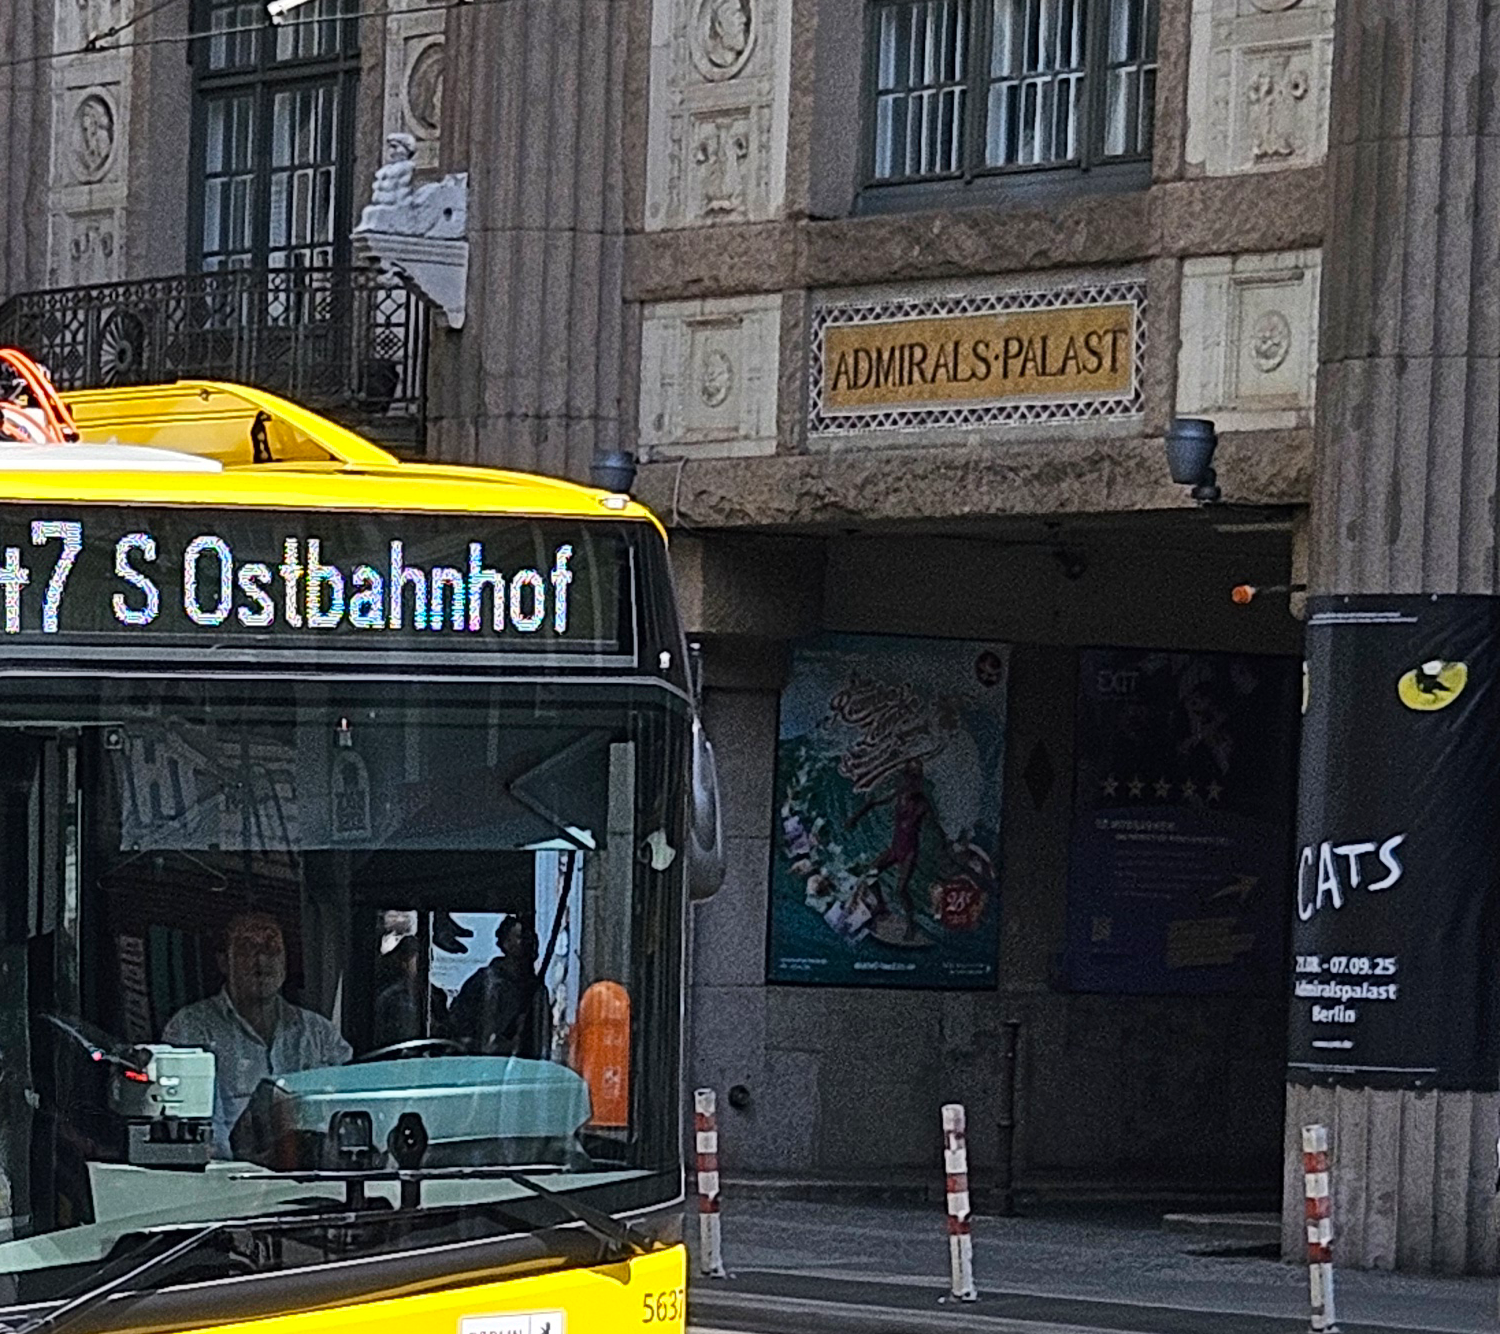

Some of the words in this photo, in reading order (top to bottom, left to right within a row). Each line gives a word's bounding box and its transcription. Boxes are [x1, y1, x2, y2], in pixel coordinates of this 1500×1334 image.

[112, 532, 160, 627] S
[183, 535, 574, 634] Ostbahnhof
[1297, 832, 1408, 921] CATS
[1312, 1005, 1356, 1023] Berlin
